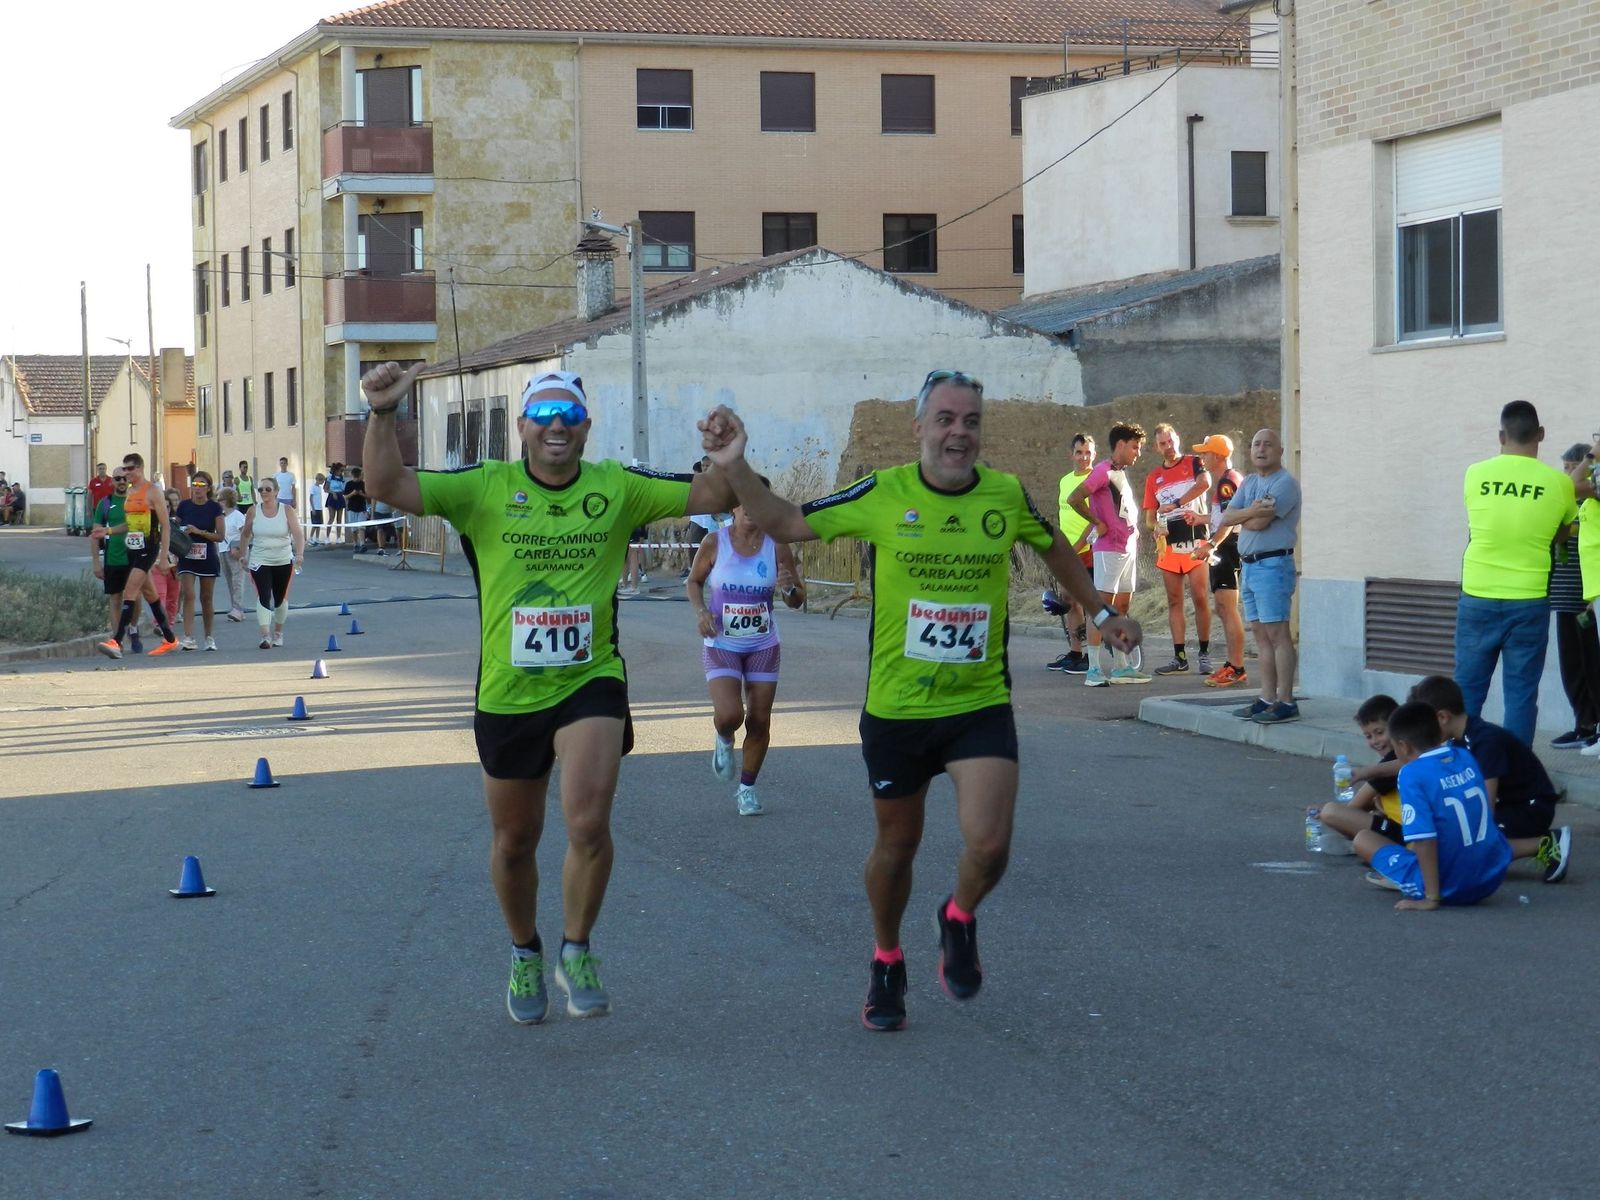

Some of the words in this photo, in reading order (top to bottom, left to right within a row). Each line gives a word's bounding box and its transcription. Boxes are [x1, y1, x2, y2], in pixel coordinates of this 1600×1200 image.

[1480, 481, 1545, 500] STAFF
[502, 532, 608, 546] CORRECAMINOS
[514, 547, 596, 560] CARBAJOSA
[895, 551, 1004, 565] CORRECAMINOS
[526, 563, 584, 572] SALAMANCA
[908, 567, 991, 580] CARBAJOSA
[920, 583, 979, 593] SALAMANCA
[514, 610, 590, 626] bedunia
[911, 603, 987, 623] bedunia
[730, 615, 762, 630] 408
[525, 626, 580, 652] 410
[919, 622, 975, 649] 434
[1443, 786, 1488, 847] 17
